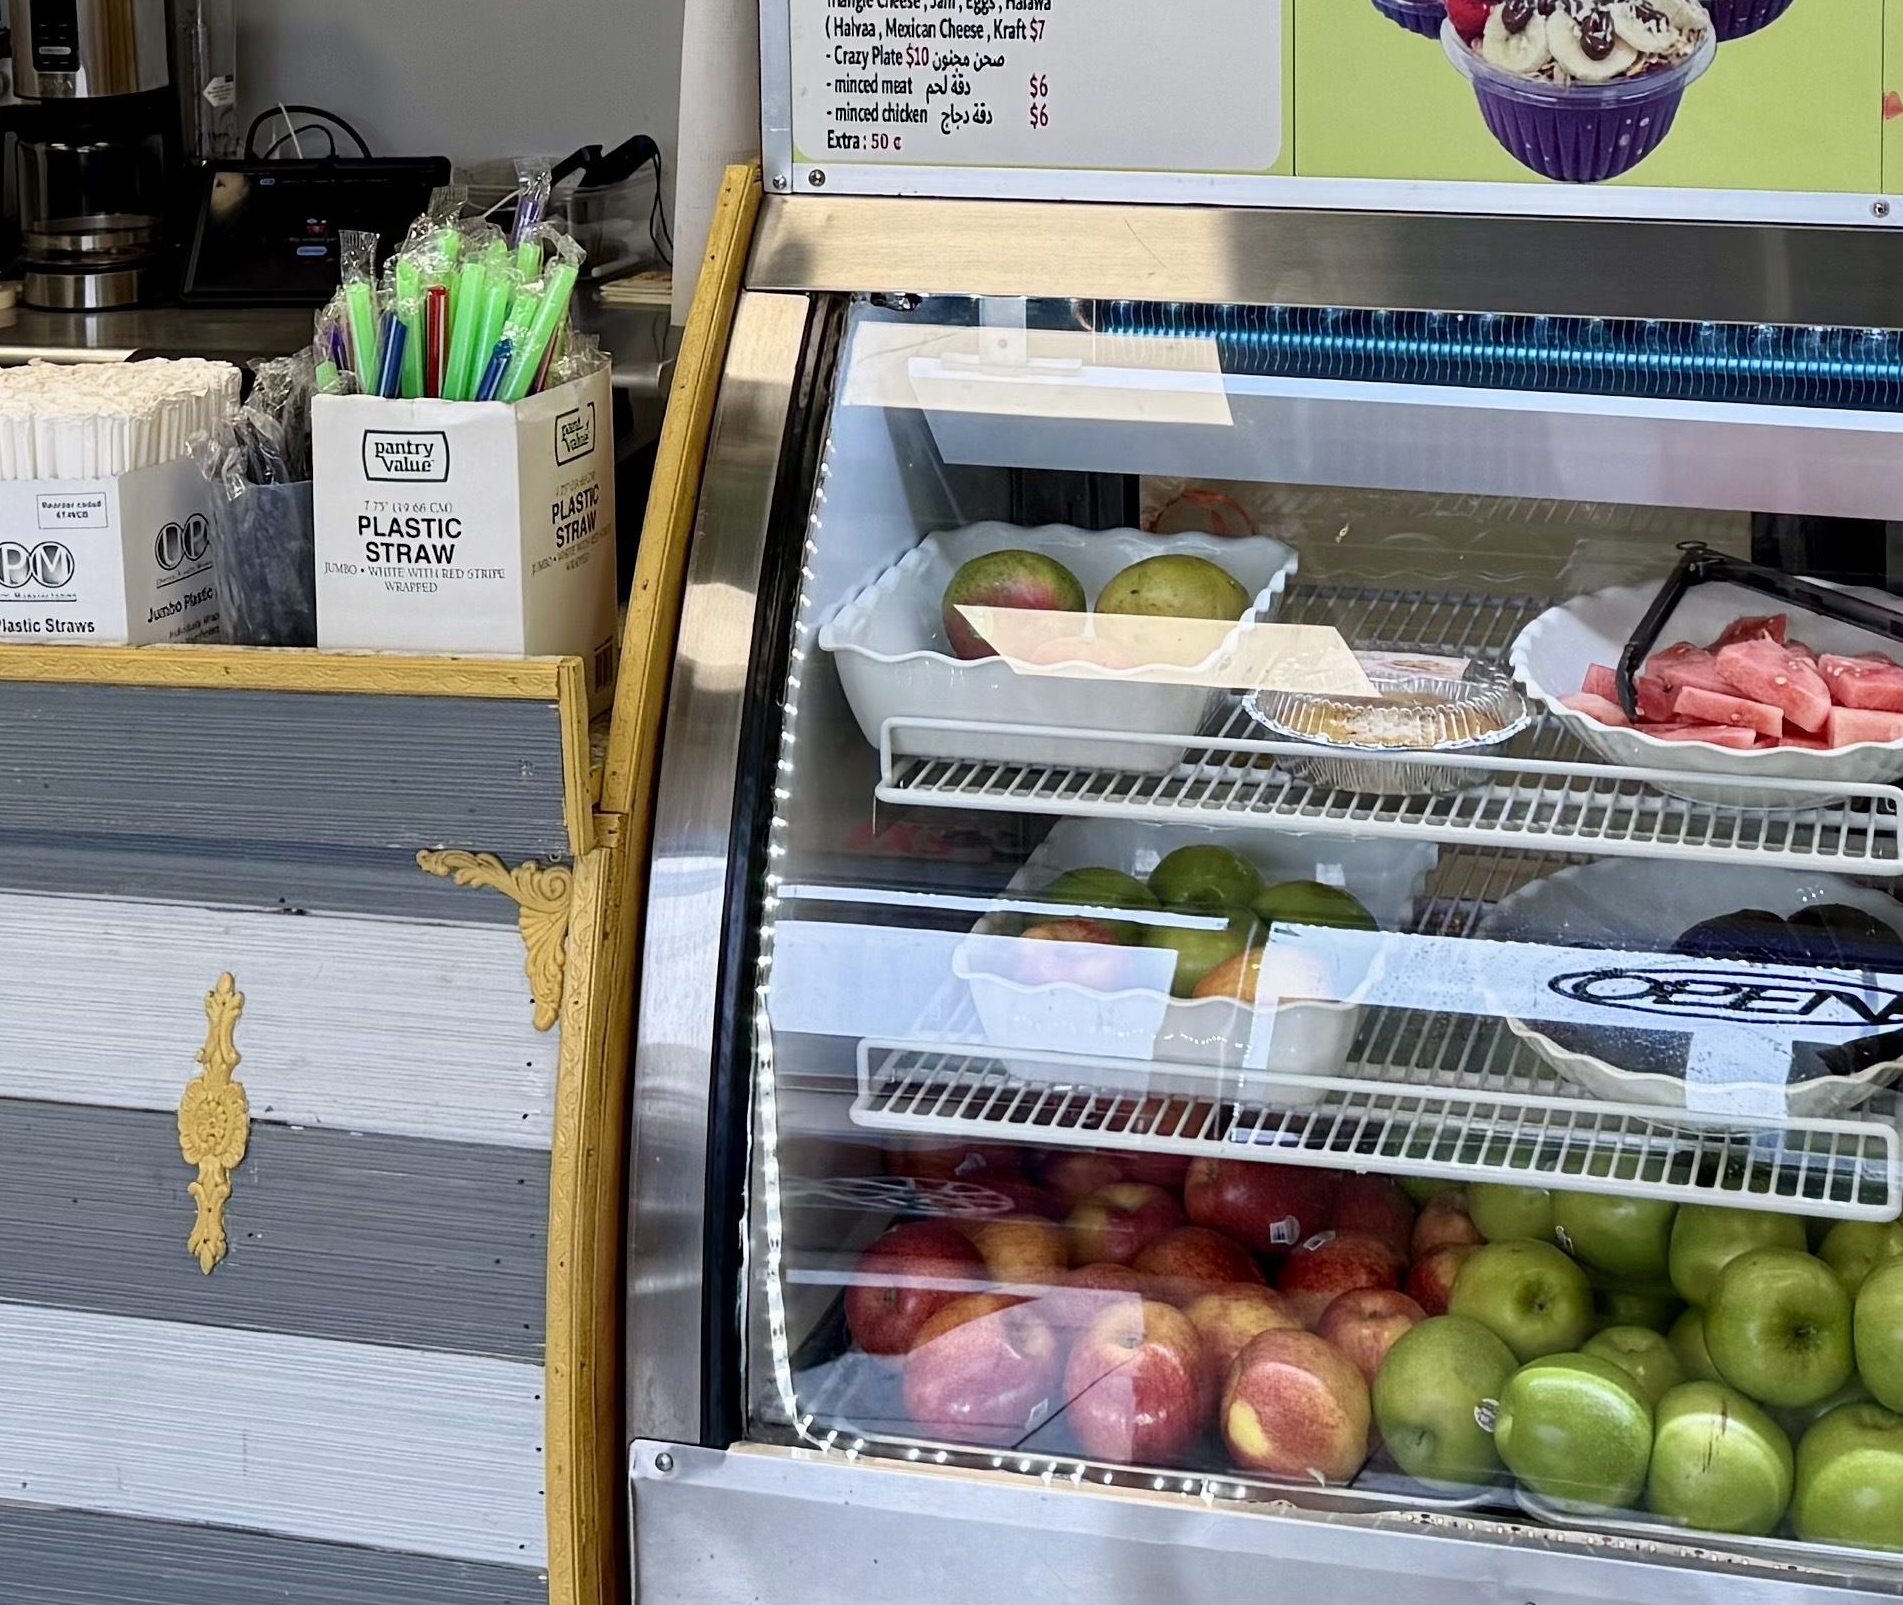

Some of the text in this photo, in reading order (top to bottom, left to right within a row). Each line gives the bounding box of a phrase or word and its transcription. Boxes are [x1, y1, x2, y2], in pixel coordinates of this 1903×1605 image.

[375, 439, 434, 458] pantry
[378, 456, 432, 473] value
[358, 516, 462, 539] PLASTIC
[365, 542, 455, 564] STRAW
[45, 618, 95, 632] Straws
